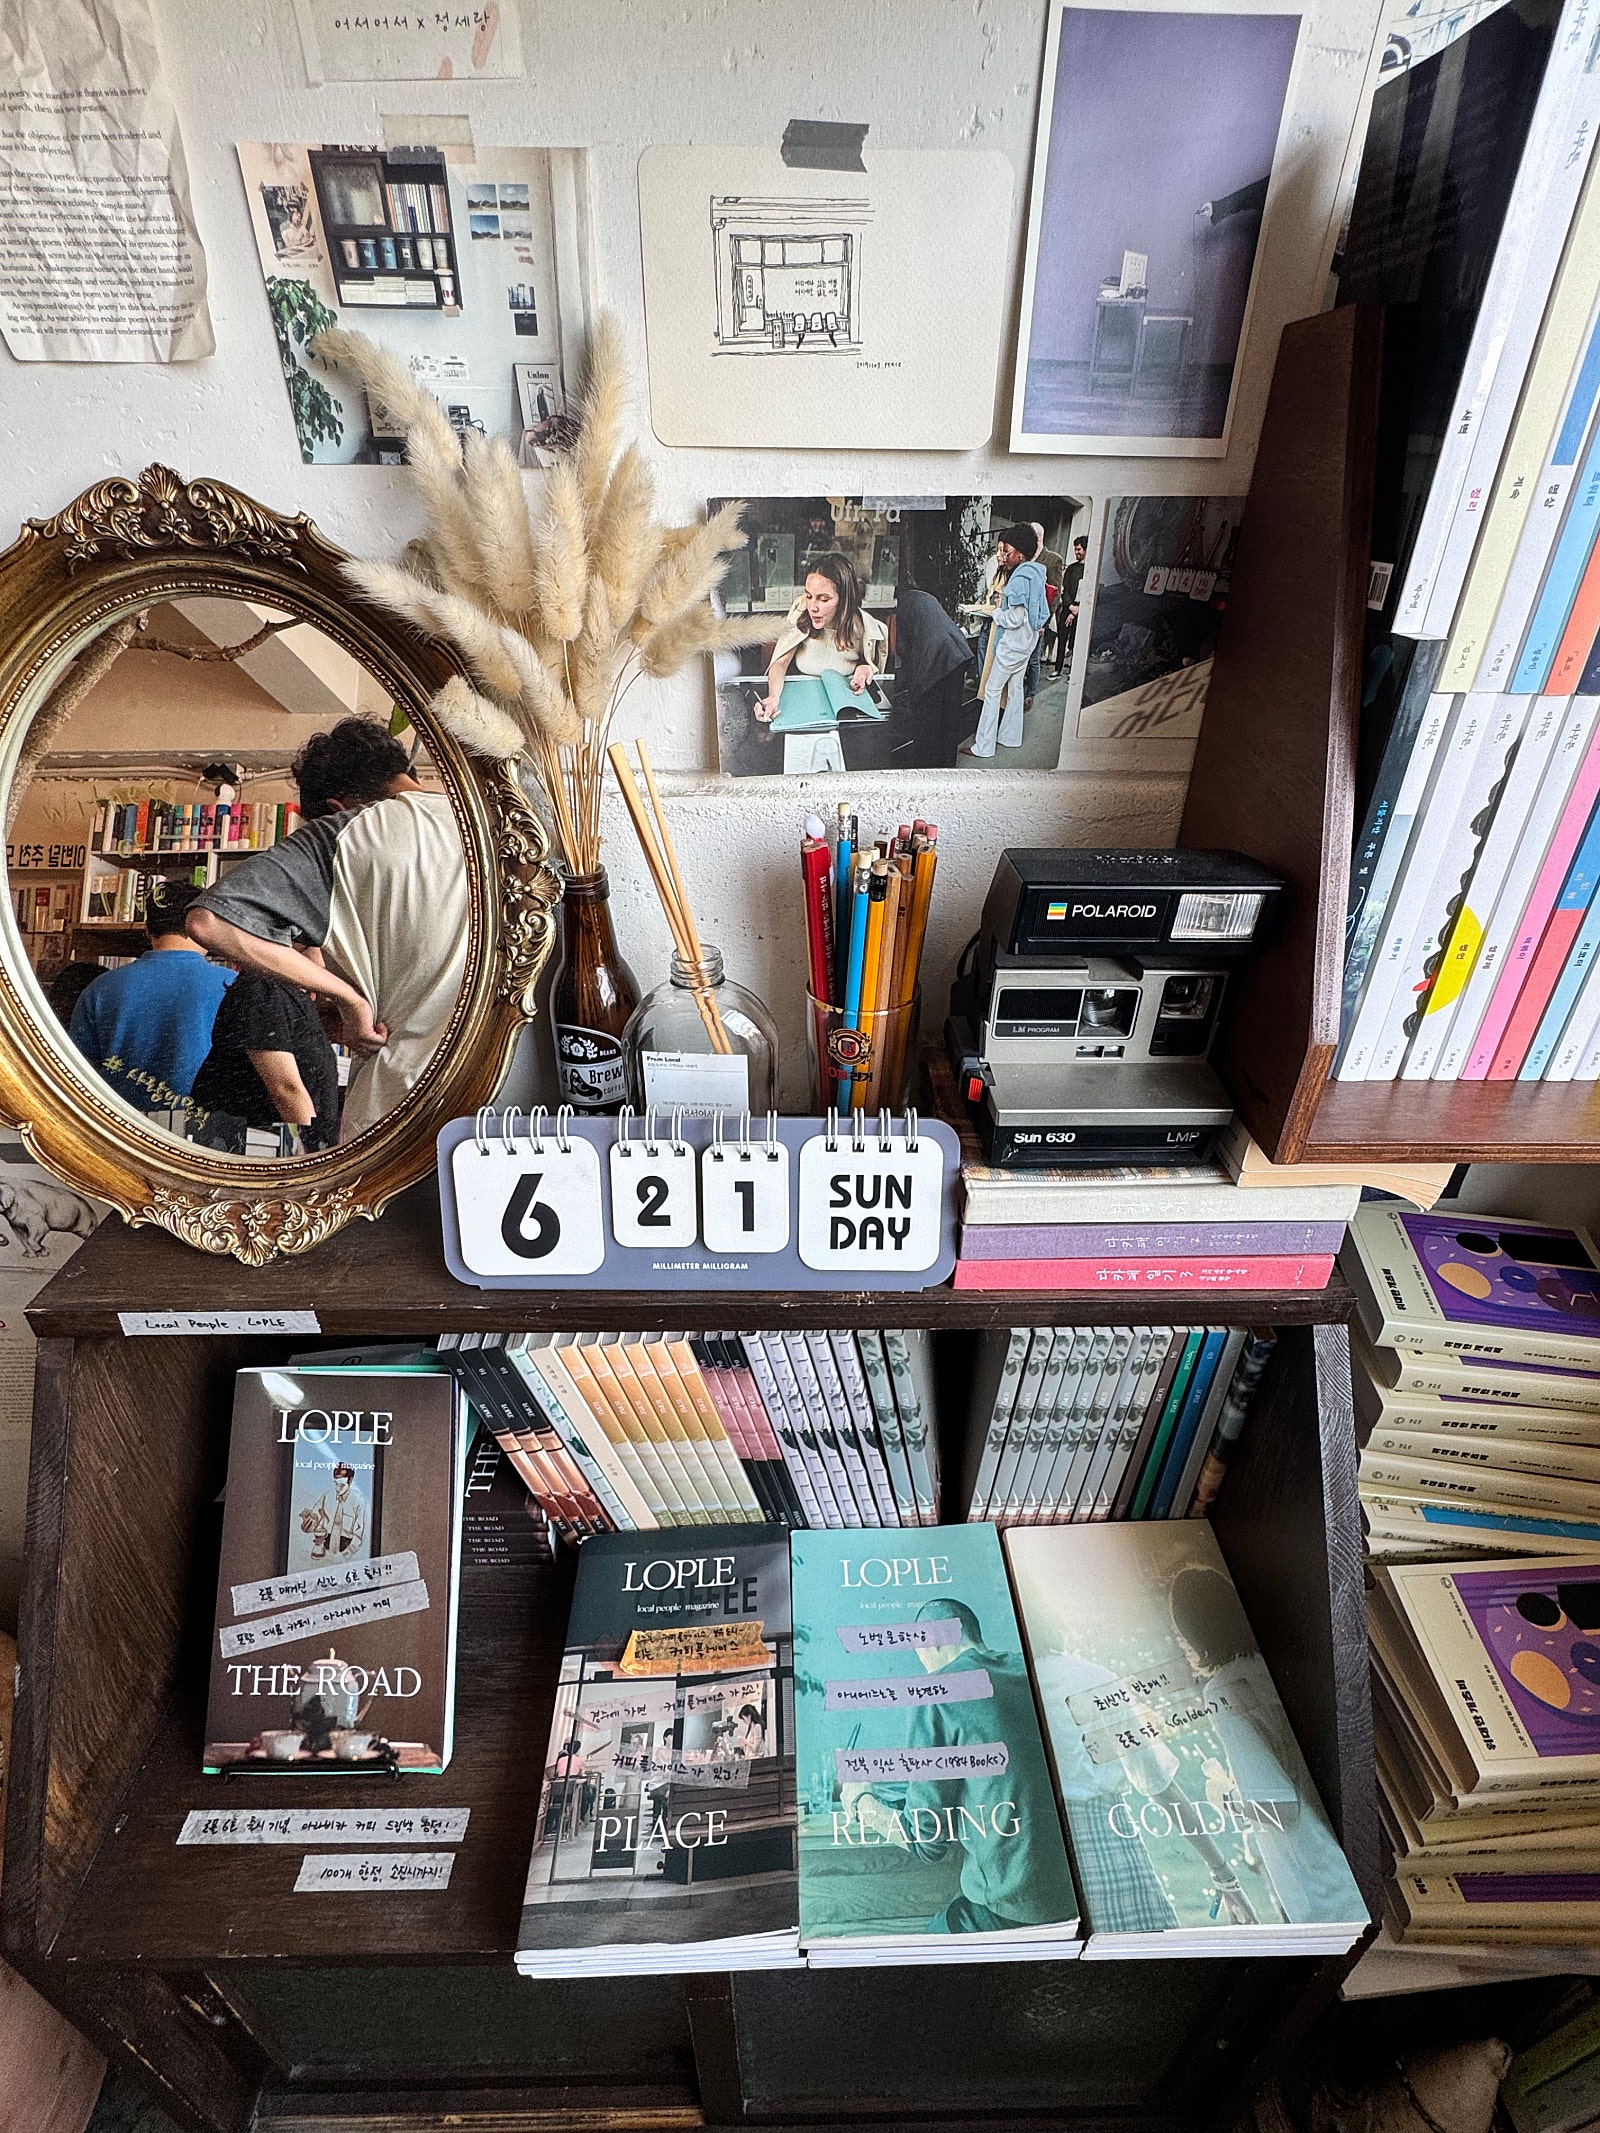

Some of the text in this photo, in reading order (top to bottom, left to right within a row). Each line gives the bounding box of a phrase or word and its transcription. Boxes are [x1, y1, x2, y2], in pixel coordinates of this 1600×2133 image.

[335, 11, 491, 32] 어서어서 정세랑
[1564, 118, 1589, 170] 아무튼,
[526, 370, 550, 380] Union
[1509, 476, 1525, 500] 계속
[1544, 484, 1560, 508] 명상
[1466, 488, 1482, 513] 정리
[1149, 573, 1161, 592] 2
[1421, 718, 1440, 750] 아무튼,
[1458, 718, 1477, 750] 아무튼,
[1535, 710, 1554, 743] 아무튼,
[1562, 722, 1582, 754] 아무튼,
[1363, 841, 1378, 860] 푸른
[1072, 904, 1157, 919] POLAROID
[1482, 944, 1499, 970] 영양제
[1516, 936, 1533, 962] 떡볶이
[1573, 941, 1591, 967] 리코더
[599, 1048, 617, 1057] BEANS
[589, 1065, 623, 1084] Brew
[1013, 1132, 1076, 1143] Sun 630
[1166, 1131, 1200, 1143] LMP
[636, 1175, 672, 1227] 2
[829, 1173, 912, 1209] SUN
[500, 1172, 561, 1259] 6
[734, 1180, 755, 1232] 1
[830, 1215, 911, 1251] DAY
[1104, 1235, 1150, 1248] 다카페
[652, 1262, 749, 1271] MILLIMETER MILLIGRAM
[1096, 1269, 1142, 1281] 다카페
[1146, 1269, 1177, 1281] 일기
[145, 1318, 179, 1329] Local
[1443, 1340, 1473, 1352] 위대한
[1461, 1386, 1490, 1396] 위대한
[479, 1403, 494, 1419] LOPLE
[500, 1403, 515, 1419] LOPLE
[521, 1402, 536, 1418] LOPLE
[276, 1409, 394, 1446] LOPLE
[295, 1459, 313, 1470] local
[341, 1461, 376, 1471] magazine
[464, 1441, 500, 1498] THE
[621, 1556, 737, 1592] LOPLE
[840, 1556, 953, 1588] LOPLE
[279, 1580, 307, 1595] 매거진
[316, 1576, 338, 1588] 신간
[323, 1604, 367, 1622] 아라비카
[372, 1598, 391, 1609] 커피
[637, 1601, 720, 1614] local people magazine
[858, 1630, 926, 1646] 노벨문학상
[669, 1641, 739, 1658] 커피플레이스
[227, 1664, 422, 1698] THE ROAD
[1093, 1673, 1171, 1712] 최신간 발매!!
[590, 1709, 620, 1723] 경주에
[624, 1704, 648, 1717] 가면
[1455, 1679, 1498, 1752] 위대한 개츠비
[1115, 1722, 1160, 1749] 로플 5호
[712, 1766, 740, 1780] 있고!
[845, 1753, 933, 1774] 전북 익산 출판사
[301, 1820, 348, 1833] 아라비카
[354, 1820, 376, 1833] 커피
[830, 1801, 1022, 1847] READING
[1108, 1798, 1285, 1839] GOLDEN
[595, 1810, 729, 1853] PLACE
[320, 1866, 352, 1880] 100개
